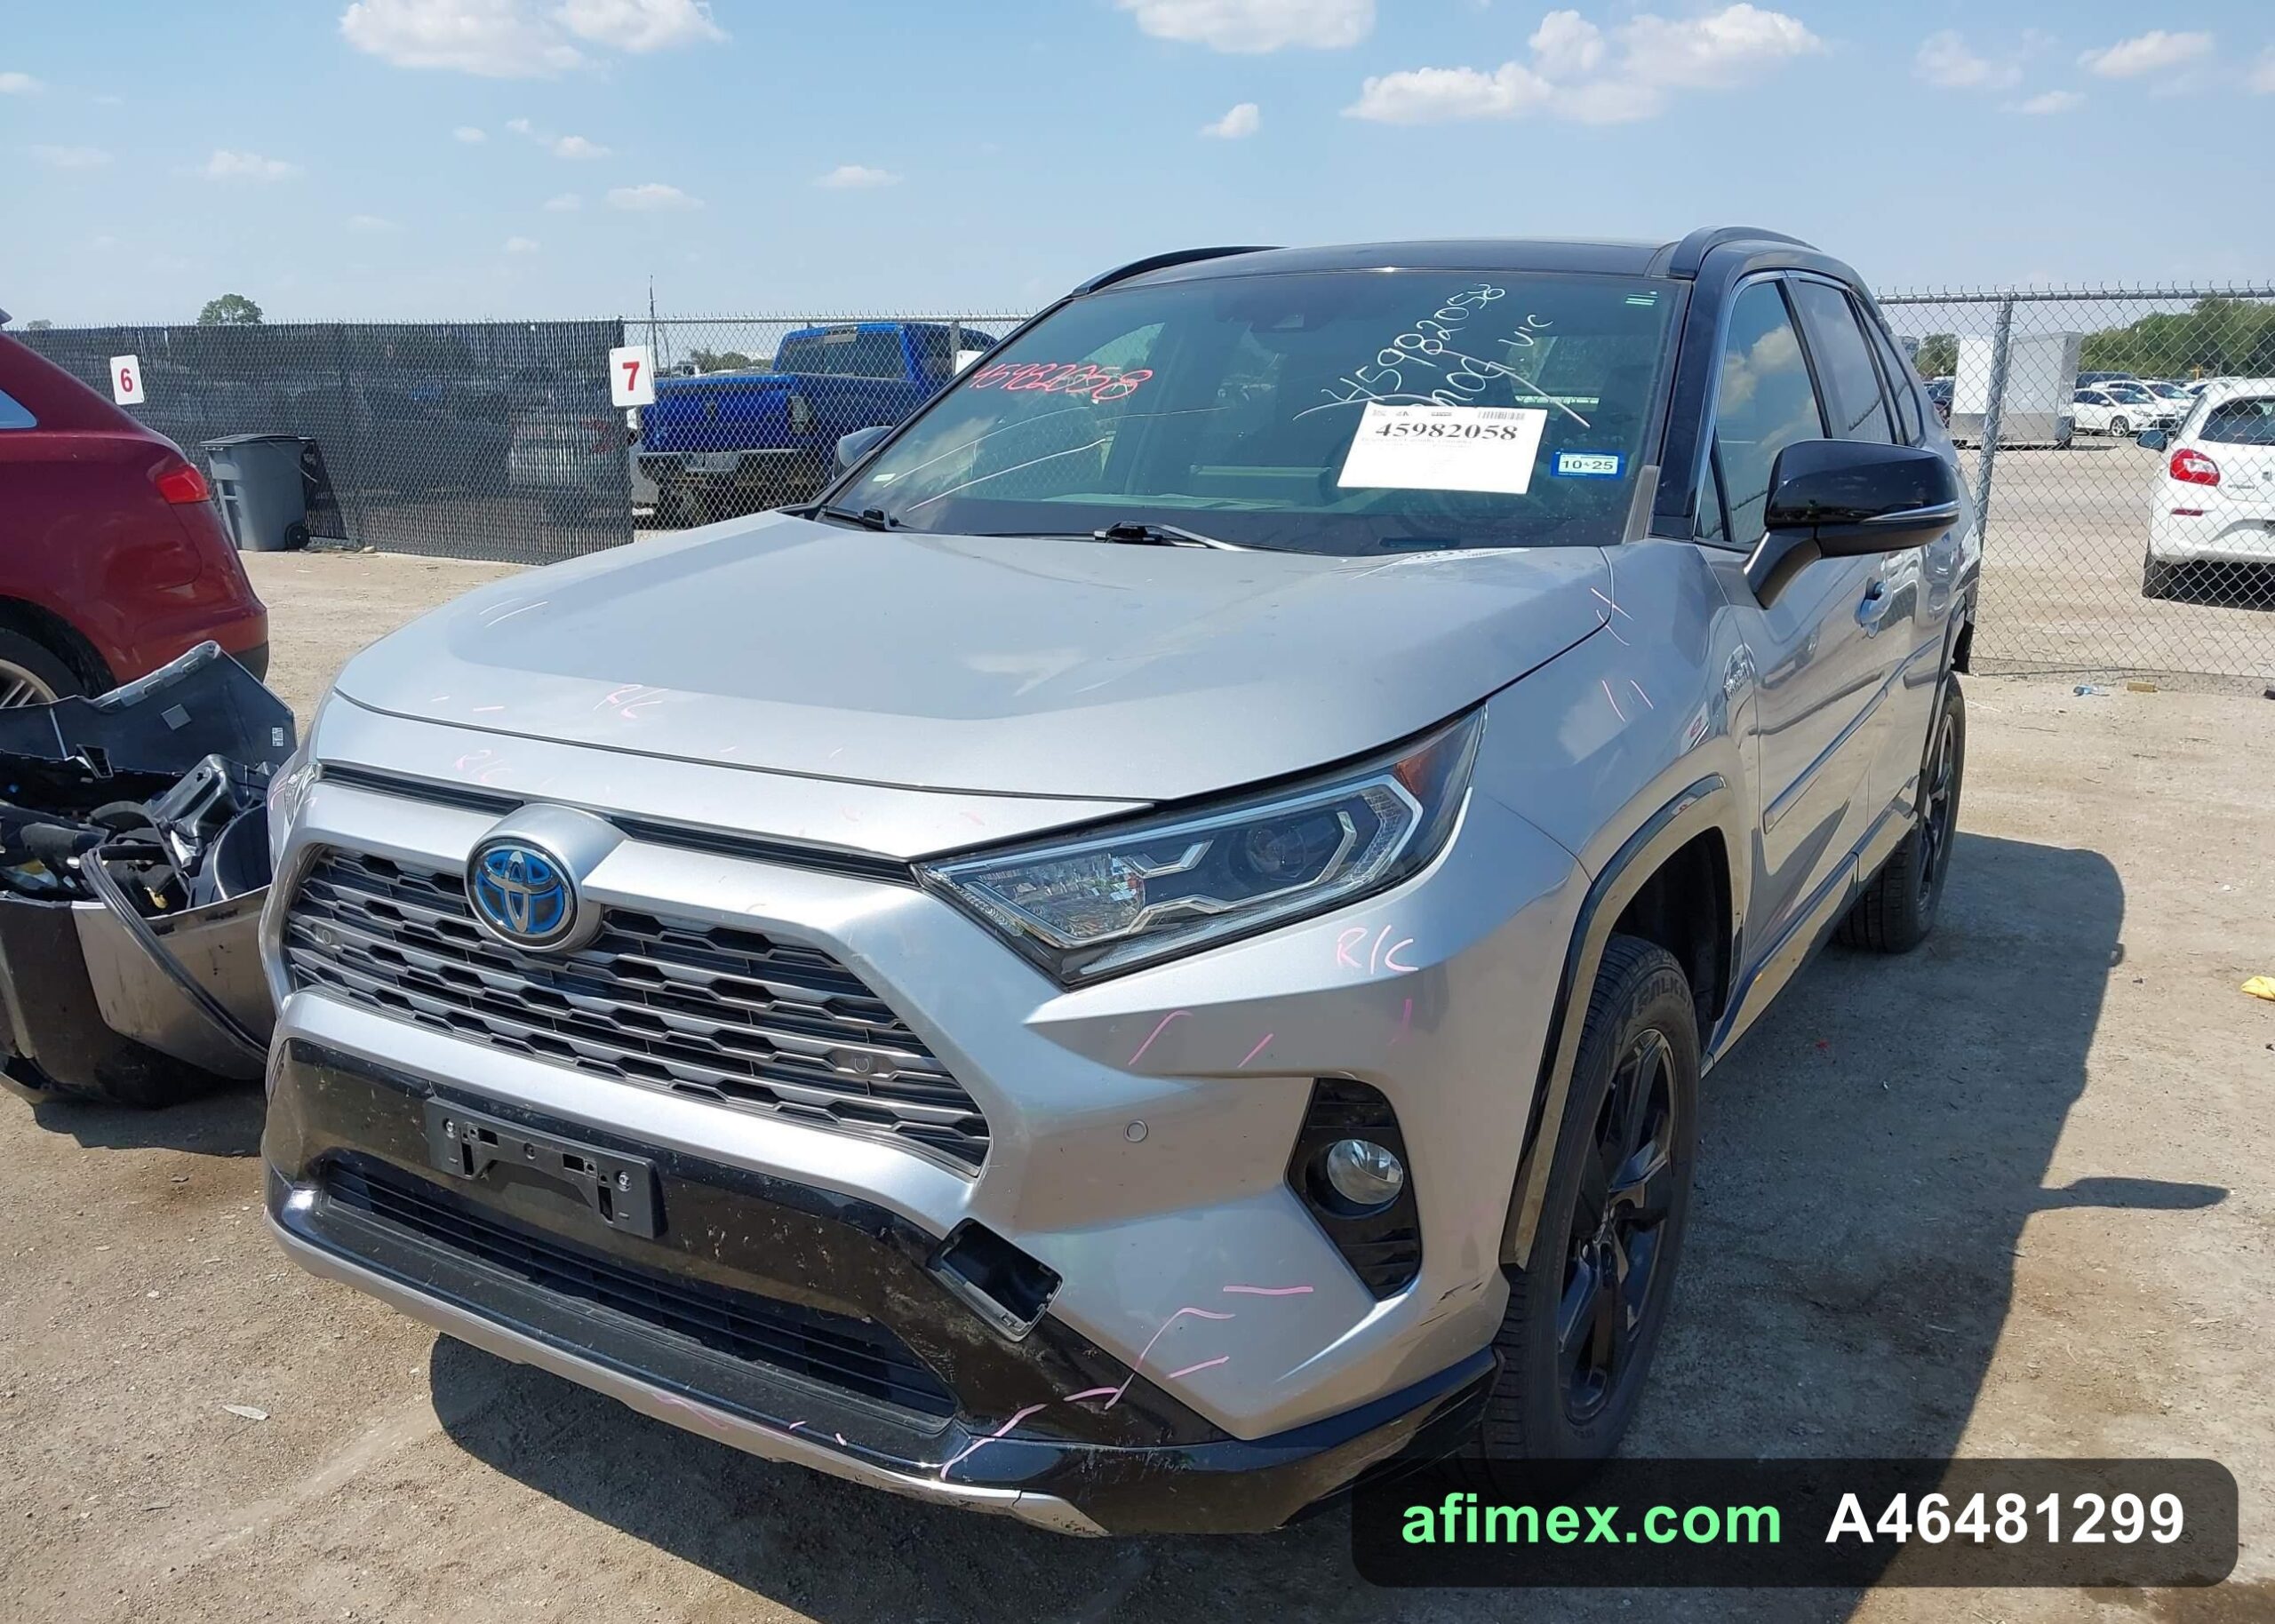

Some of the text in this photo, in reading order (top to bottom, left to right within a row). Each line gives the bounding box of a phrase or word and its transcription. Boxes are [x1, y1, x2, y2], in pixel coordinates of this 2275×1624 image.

[120, 368, 133, 393] 6
[622, 361, 640, 391] 7
[1375, 422, 1519, 442] 45982058
